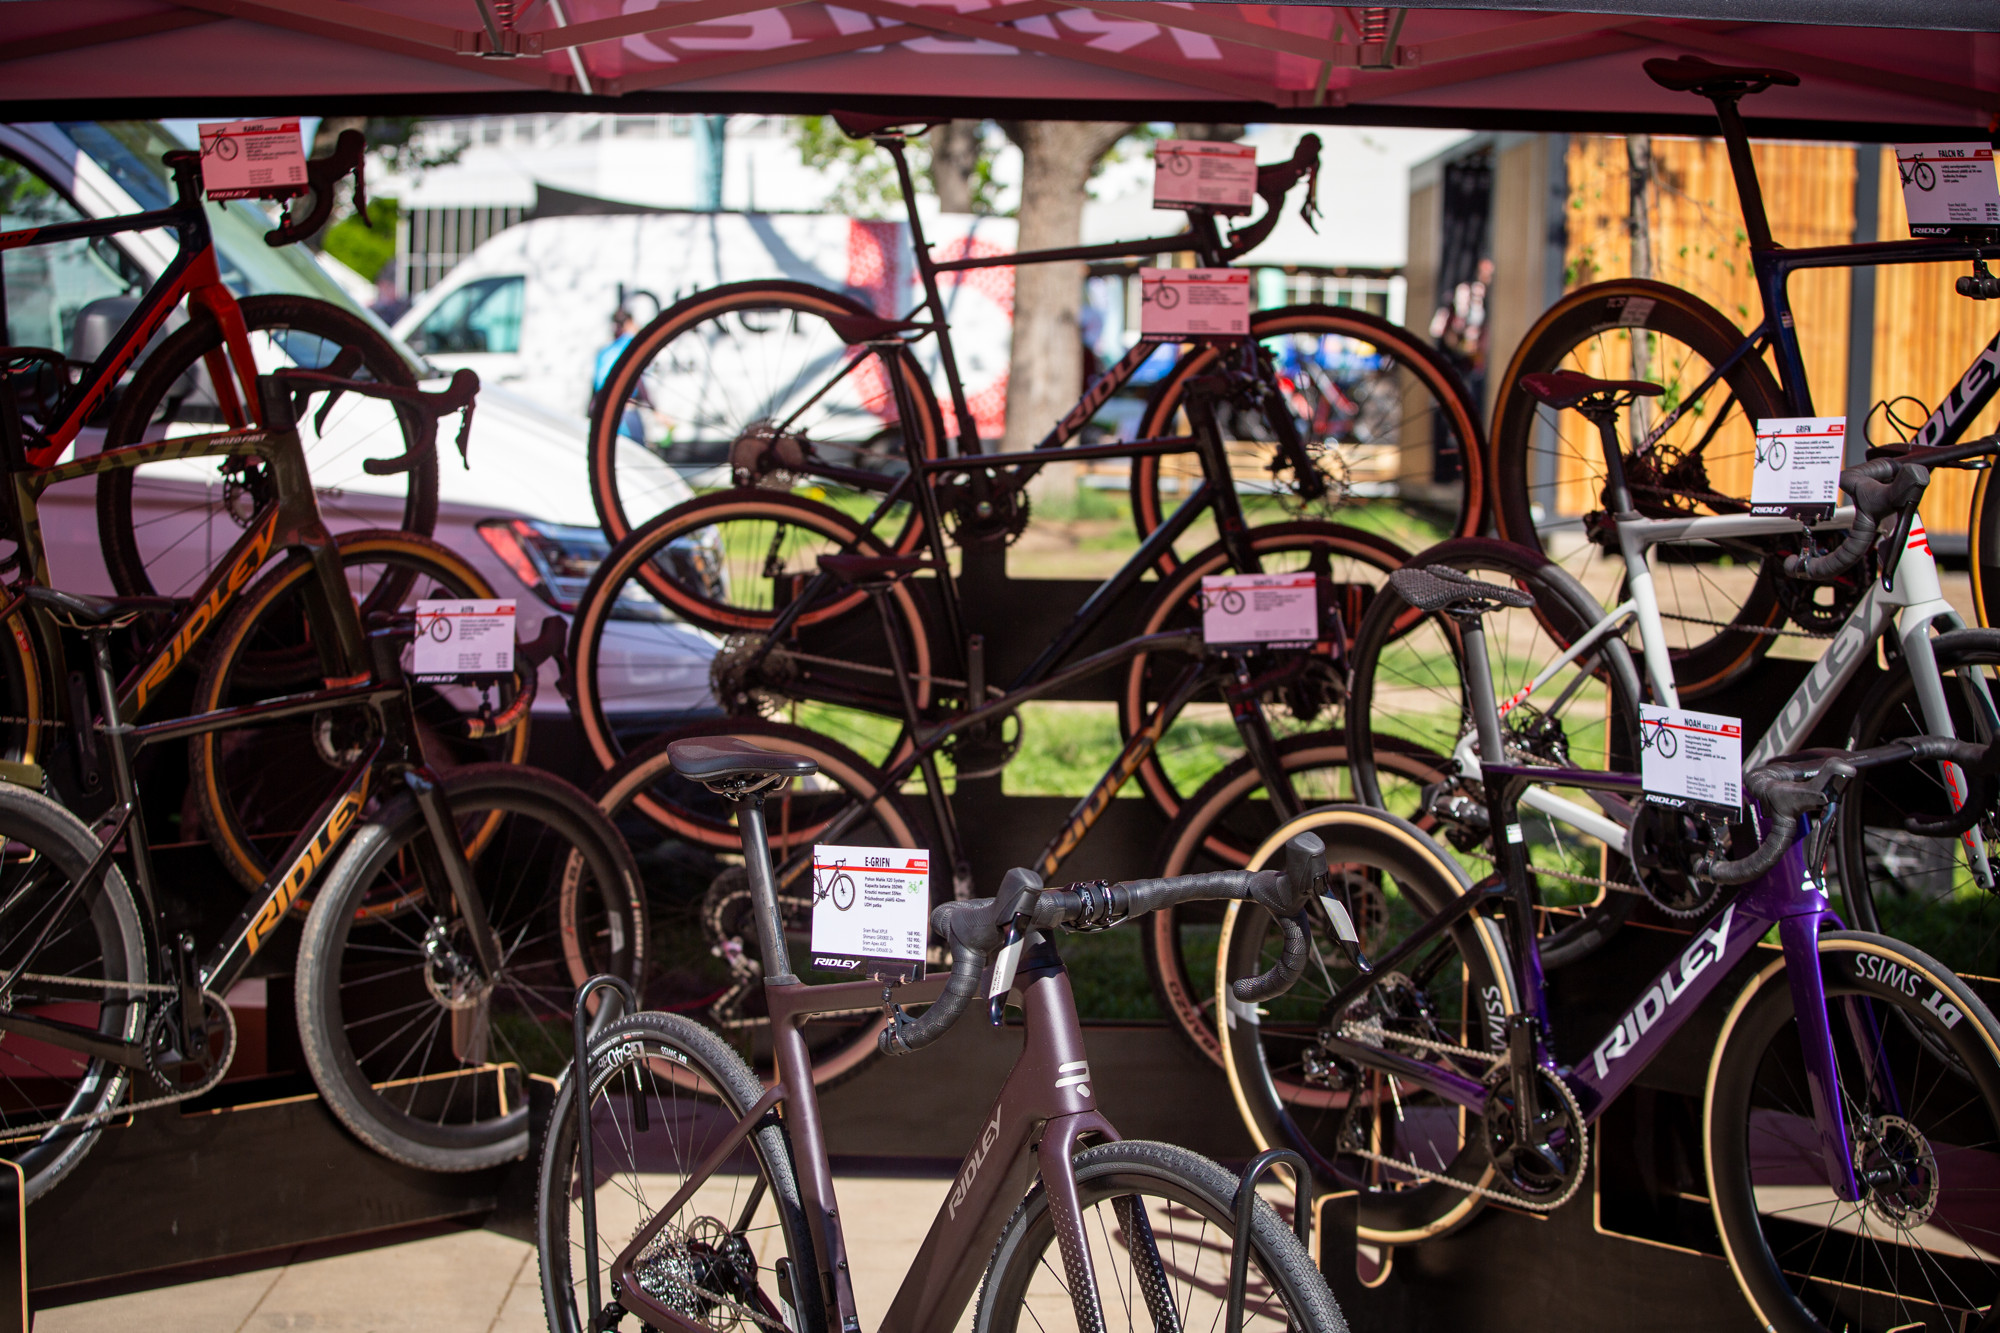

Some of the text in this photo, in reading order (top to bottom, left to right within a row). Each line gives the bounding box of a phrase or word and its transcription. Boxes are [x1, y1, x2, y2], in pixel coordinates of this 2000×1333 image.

[1752, 506, 1787, 514] RIDLEY
[137, 510, 279, 711] RIDLEY
[1684, 718, 1701, 728] NOAH
[1646, 794, 1686, 807] RIDLEY
[246, 765, 372, 956] RIDLEY
[865, 857, 890, 867] E-GRIFN
[814, 957, 861, 969] RIDLEY
[1593, 903, 1736, 1080] RIDLEY
[1855, 952, 1963, 1030] DT SWISS
[1482, 985, 1507, 1051] WISS
[660, 1046, 688, 1064] DT SWISS
[949, 1103, 1002, 1221] RIDLEY
